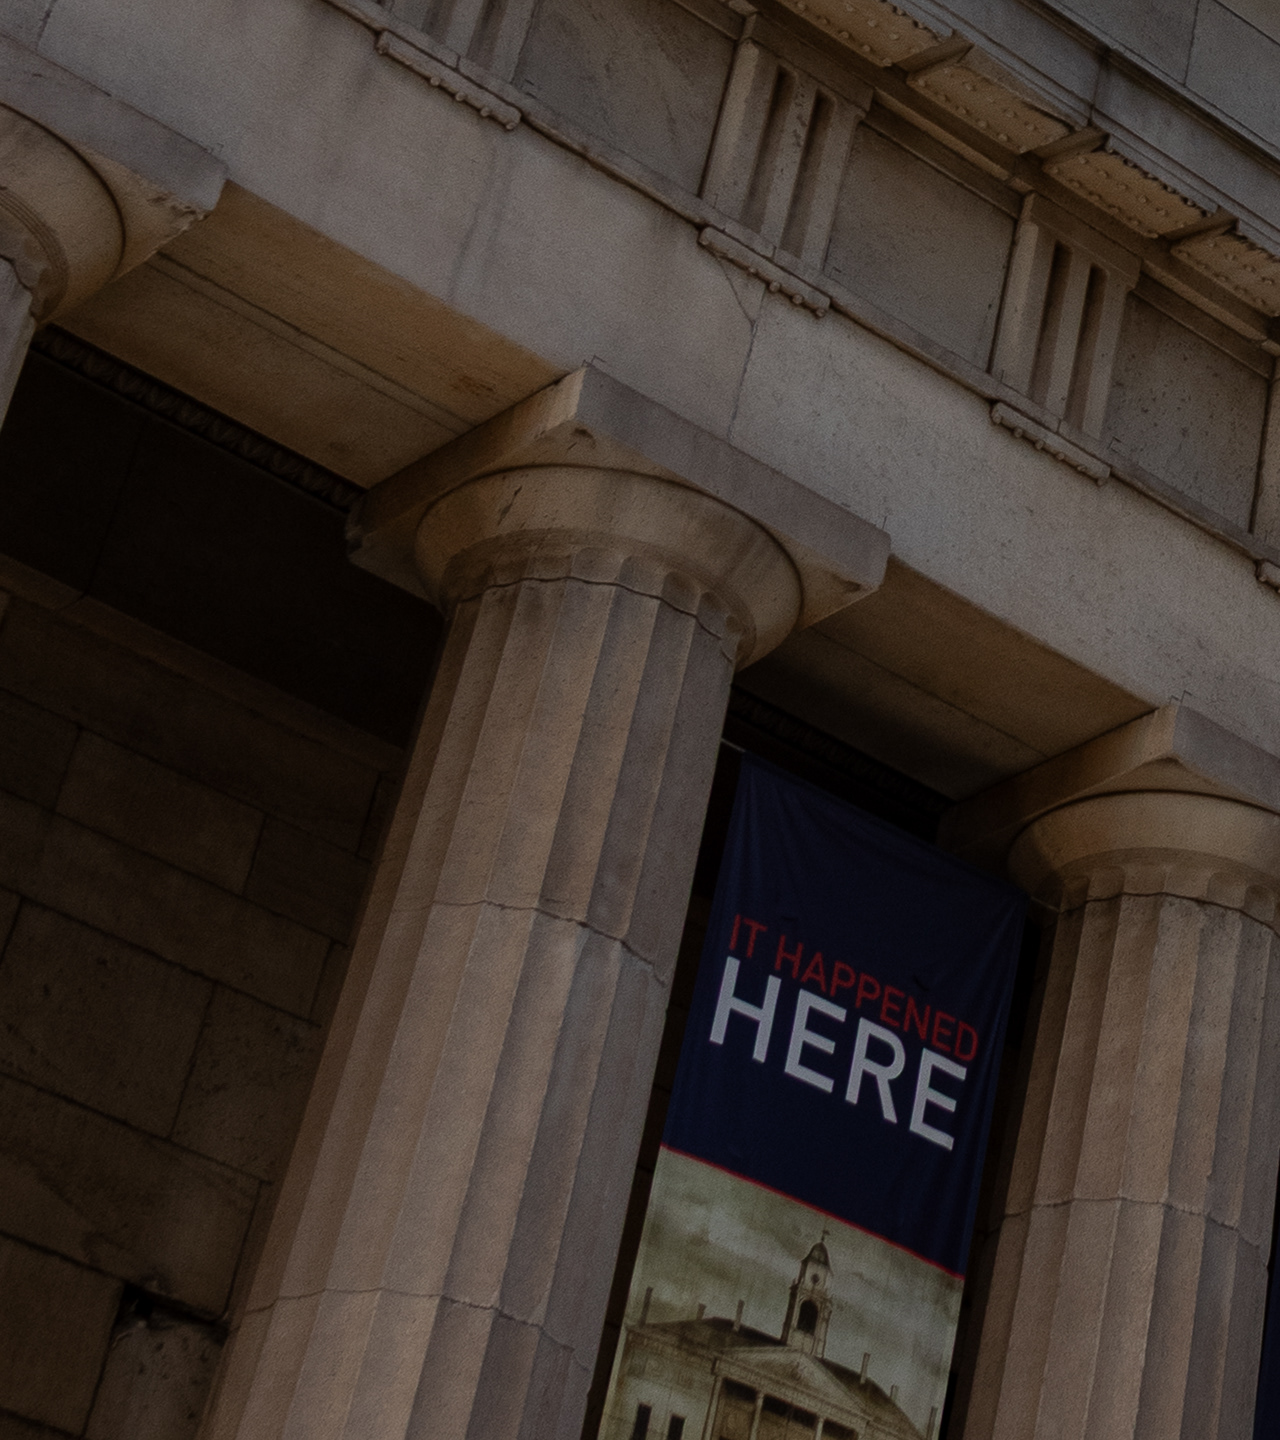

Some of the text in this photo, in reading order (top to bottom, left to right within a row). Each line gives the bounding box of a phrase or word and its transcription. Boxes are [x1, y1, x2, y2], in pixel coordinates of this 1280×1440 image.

[708, 956, 968, 1151] HERE
[728, 914, 979, 1062] IT HAPPENED
